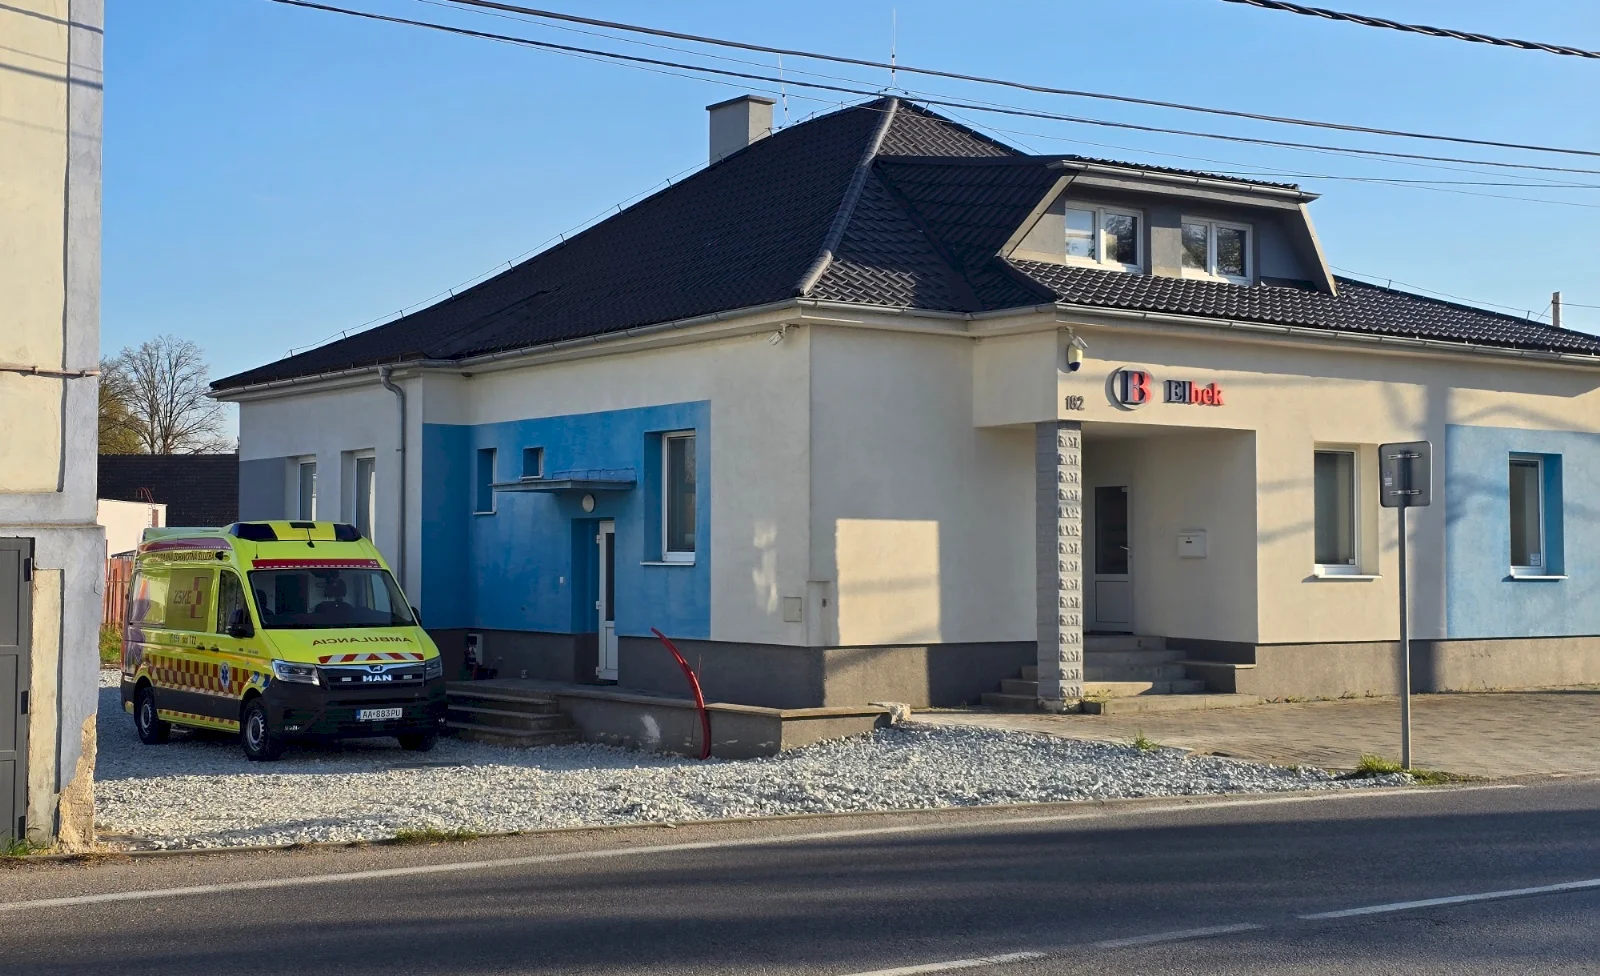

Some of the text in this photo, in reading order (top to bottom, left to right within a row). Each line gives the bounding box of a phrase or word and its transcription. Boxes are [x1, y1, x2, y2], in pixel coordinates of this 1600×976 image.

[1164, 379, 1224, 405] Elbek
[1065, 395, 1085, 410] 182
[362, 674, 392, 682] MAN
